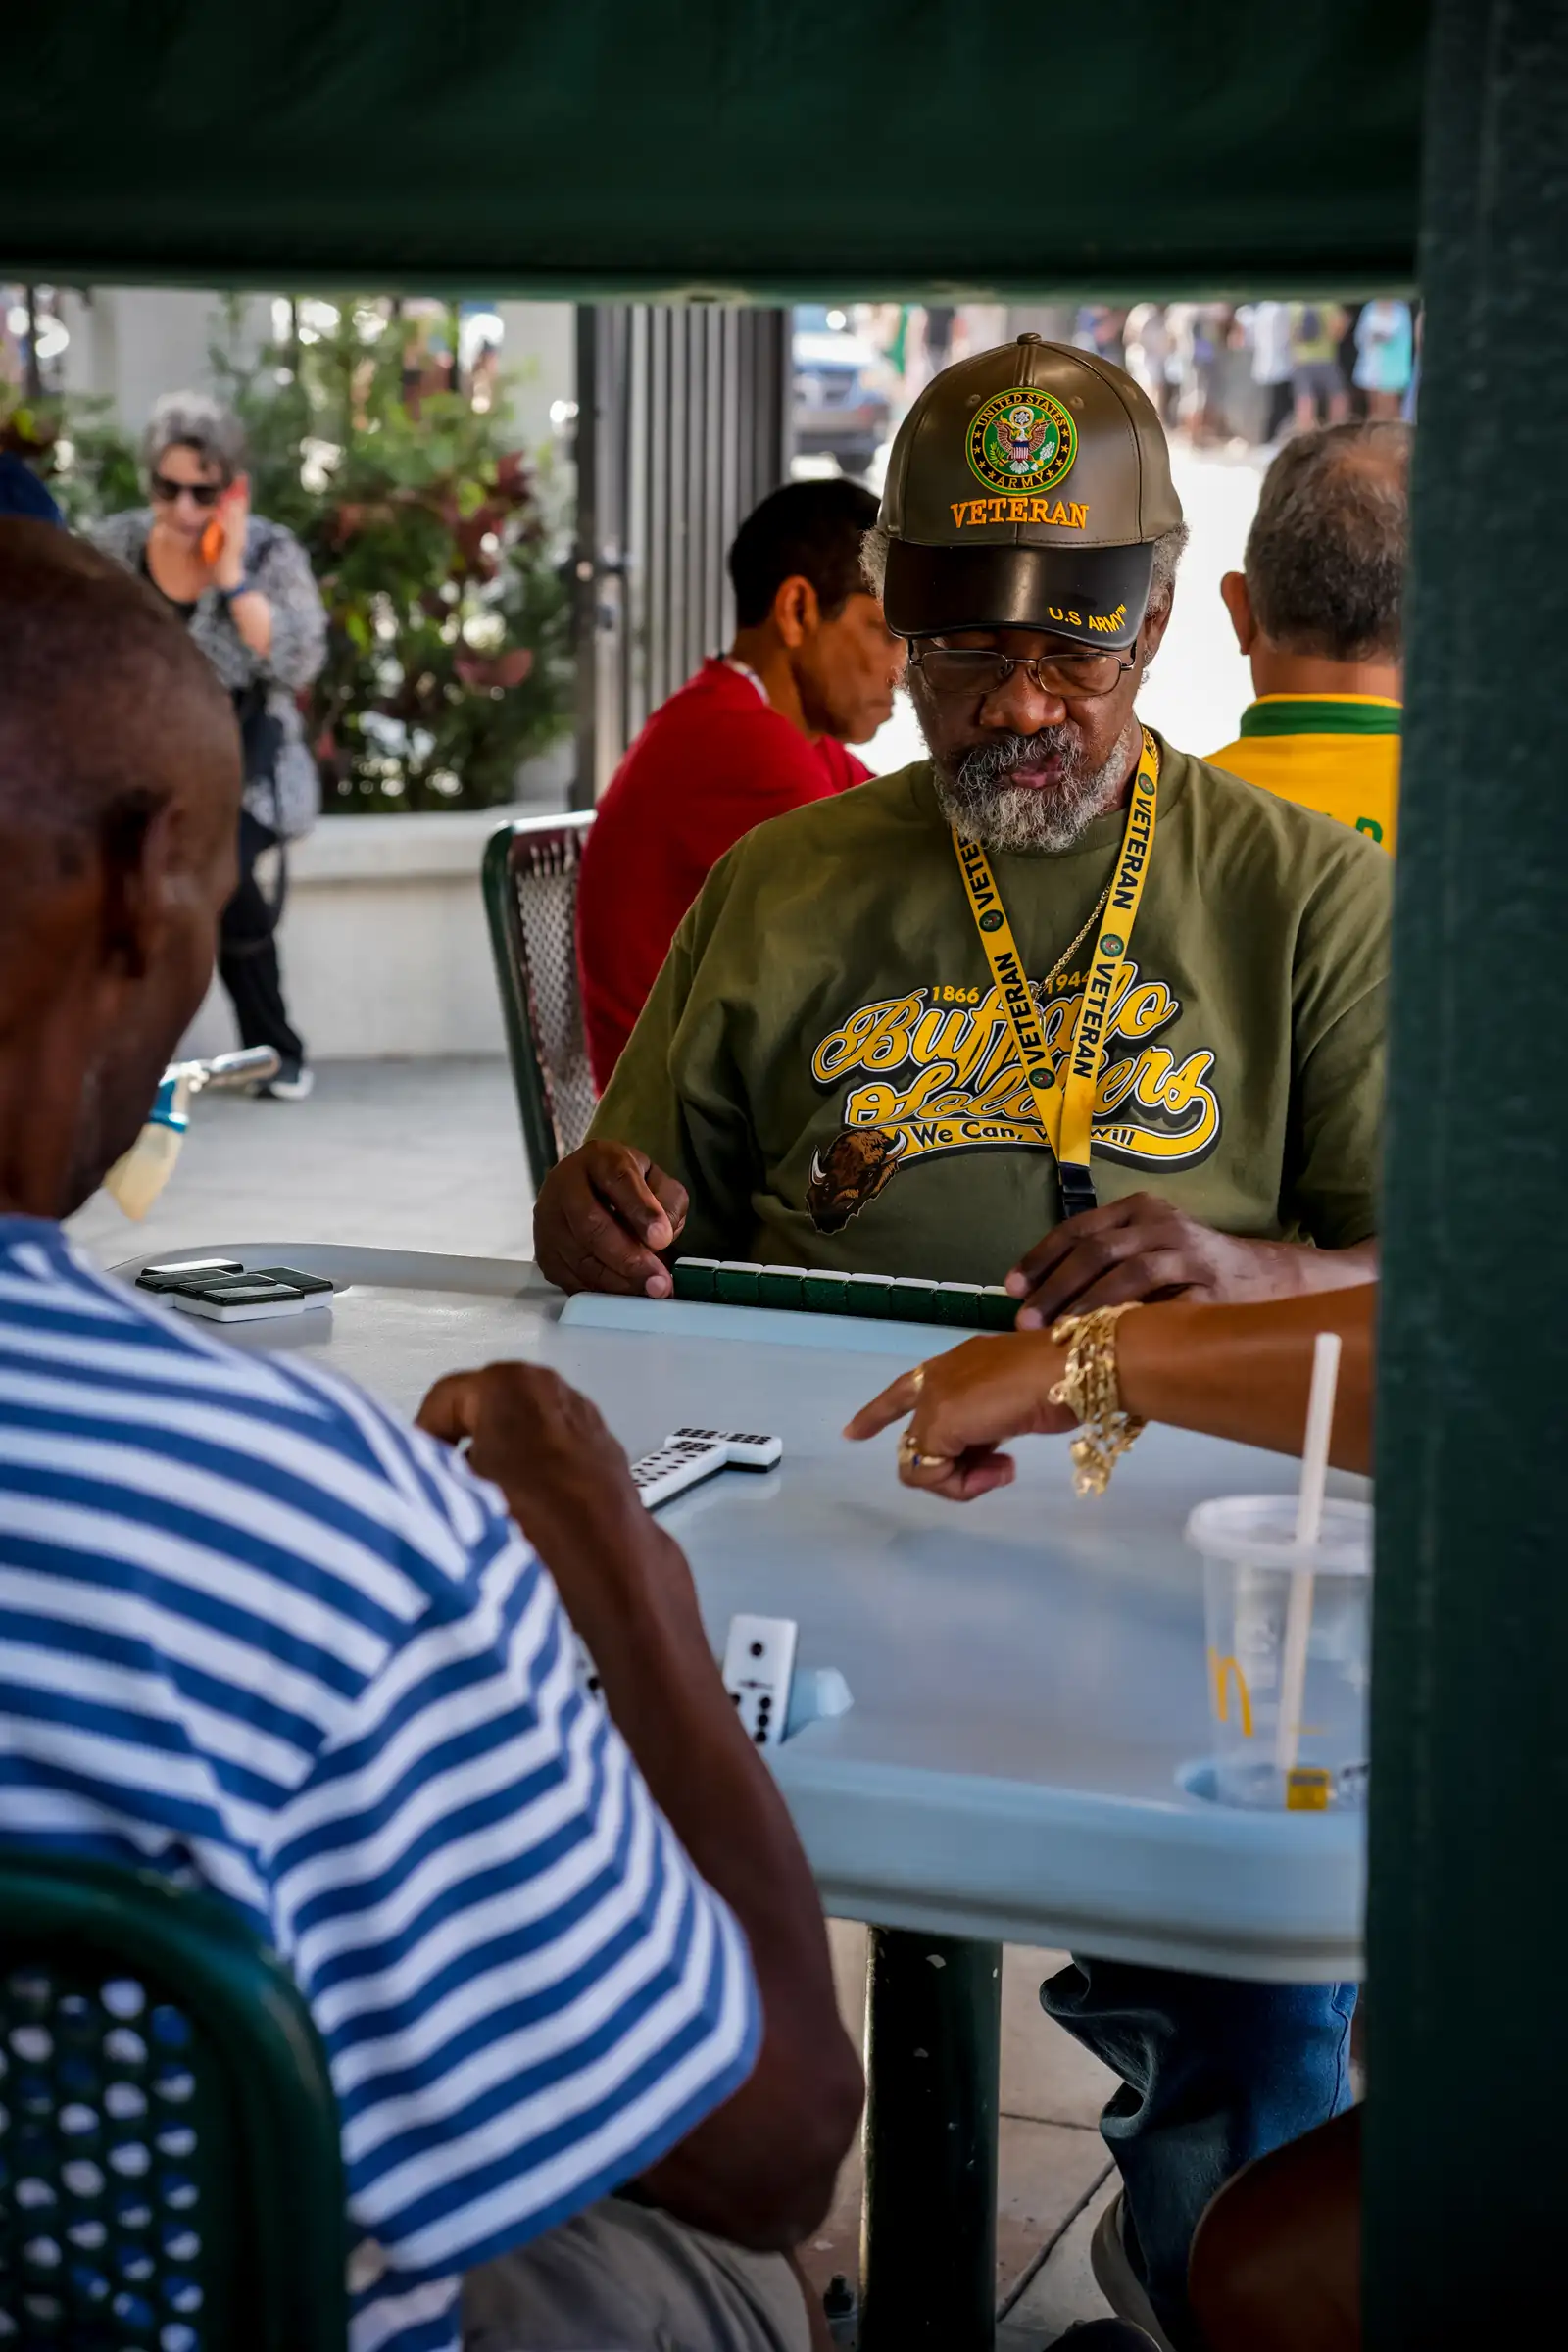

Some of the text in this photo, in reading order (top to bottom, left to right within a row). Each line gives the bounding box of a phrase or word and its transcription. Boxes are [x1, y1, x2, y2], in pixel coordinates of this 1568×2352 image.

[978, 394, 1067, 427] UNITED STATES
[996, 470, 1045, 488] ARMY
[950, 497, 1090, 529] VETERAN
[1112, 796, 1152, 911] VETERAN
[931, 985, 980, 1004] 1866
[993, 951, 1046, 1066] VETERAN
[1072, 962, 1116, 1079] VETERAN
[909, 1122, 953, 1149] We
[960, 1121, 1023, 1141] Can,
